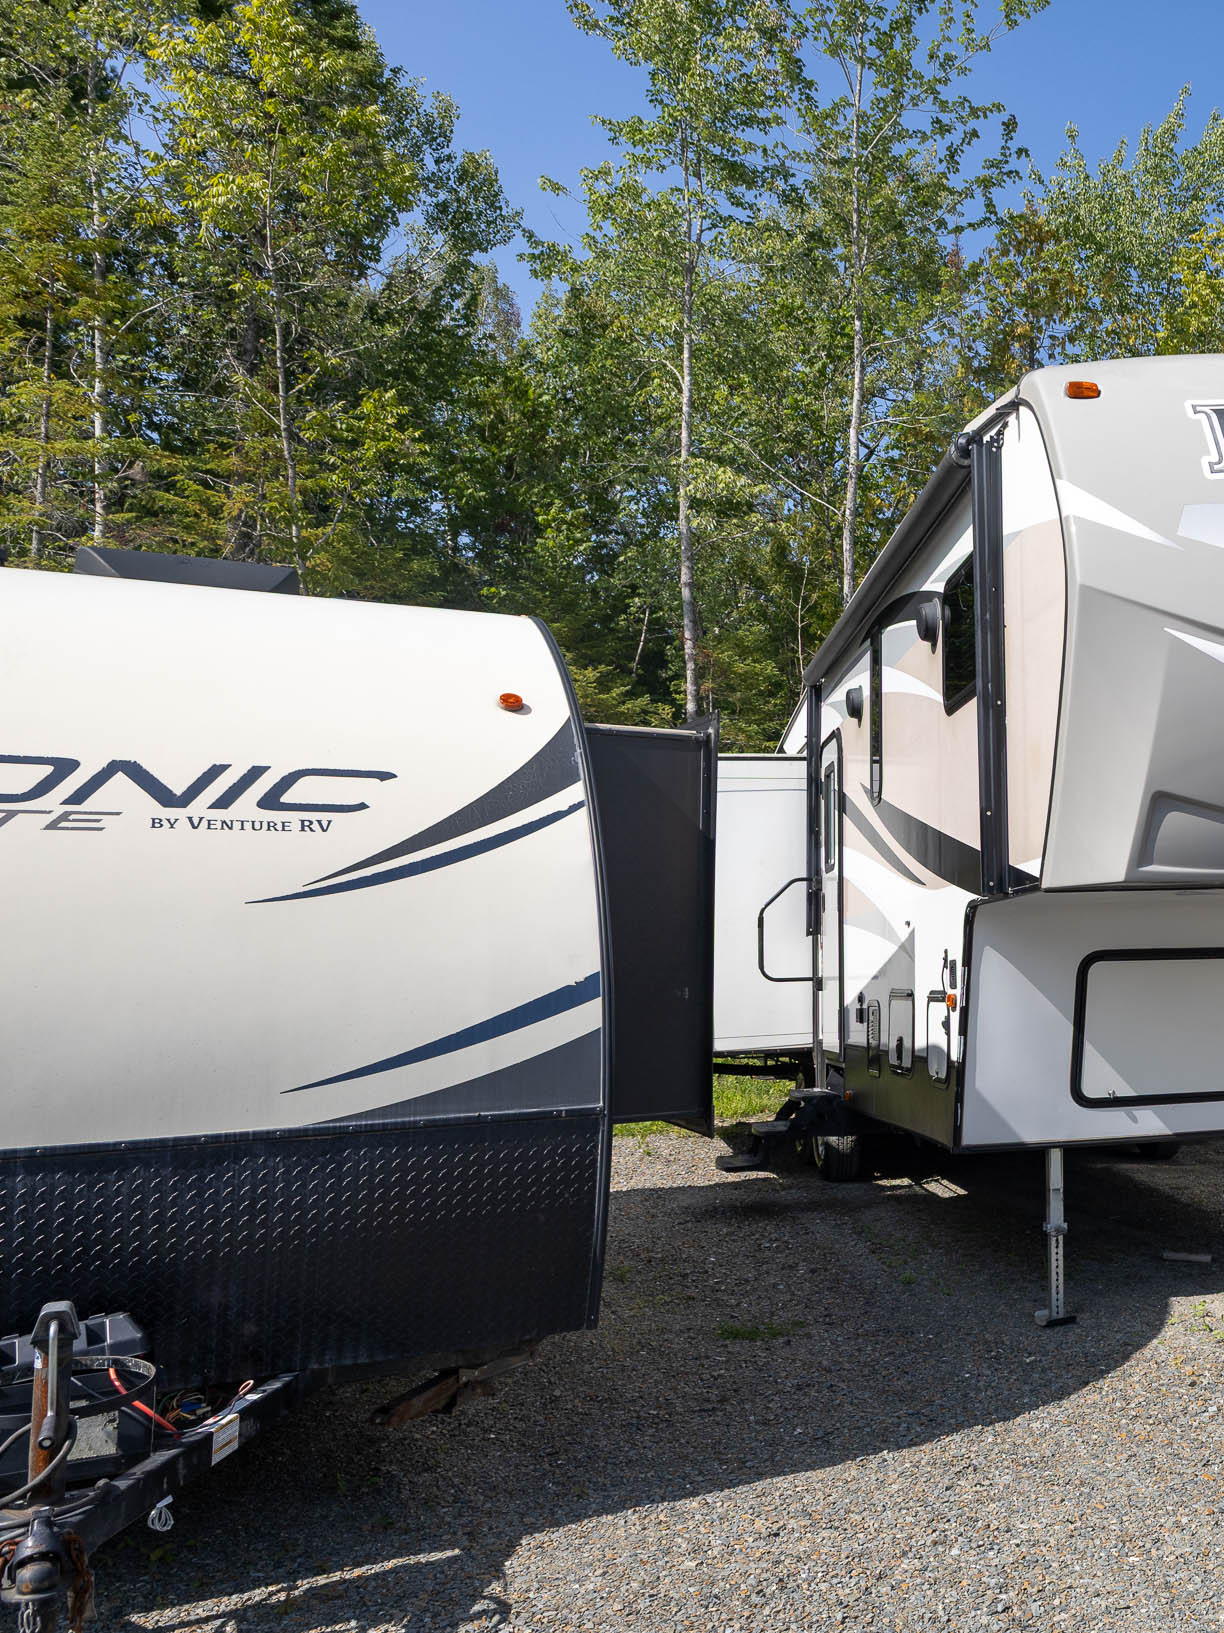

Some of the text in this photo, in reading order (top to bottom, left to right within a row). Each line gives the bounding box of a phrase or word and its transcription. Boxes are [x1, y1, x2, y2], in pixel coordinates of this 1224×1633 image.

[150, 816, 333, 833] BY VENTURE RV
